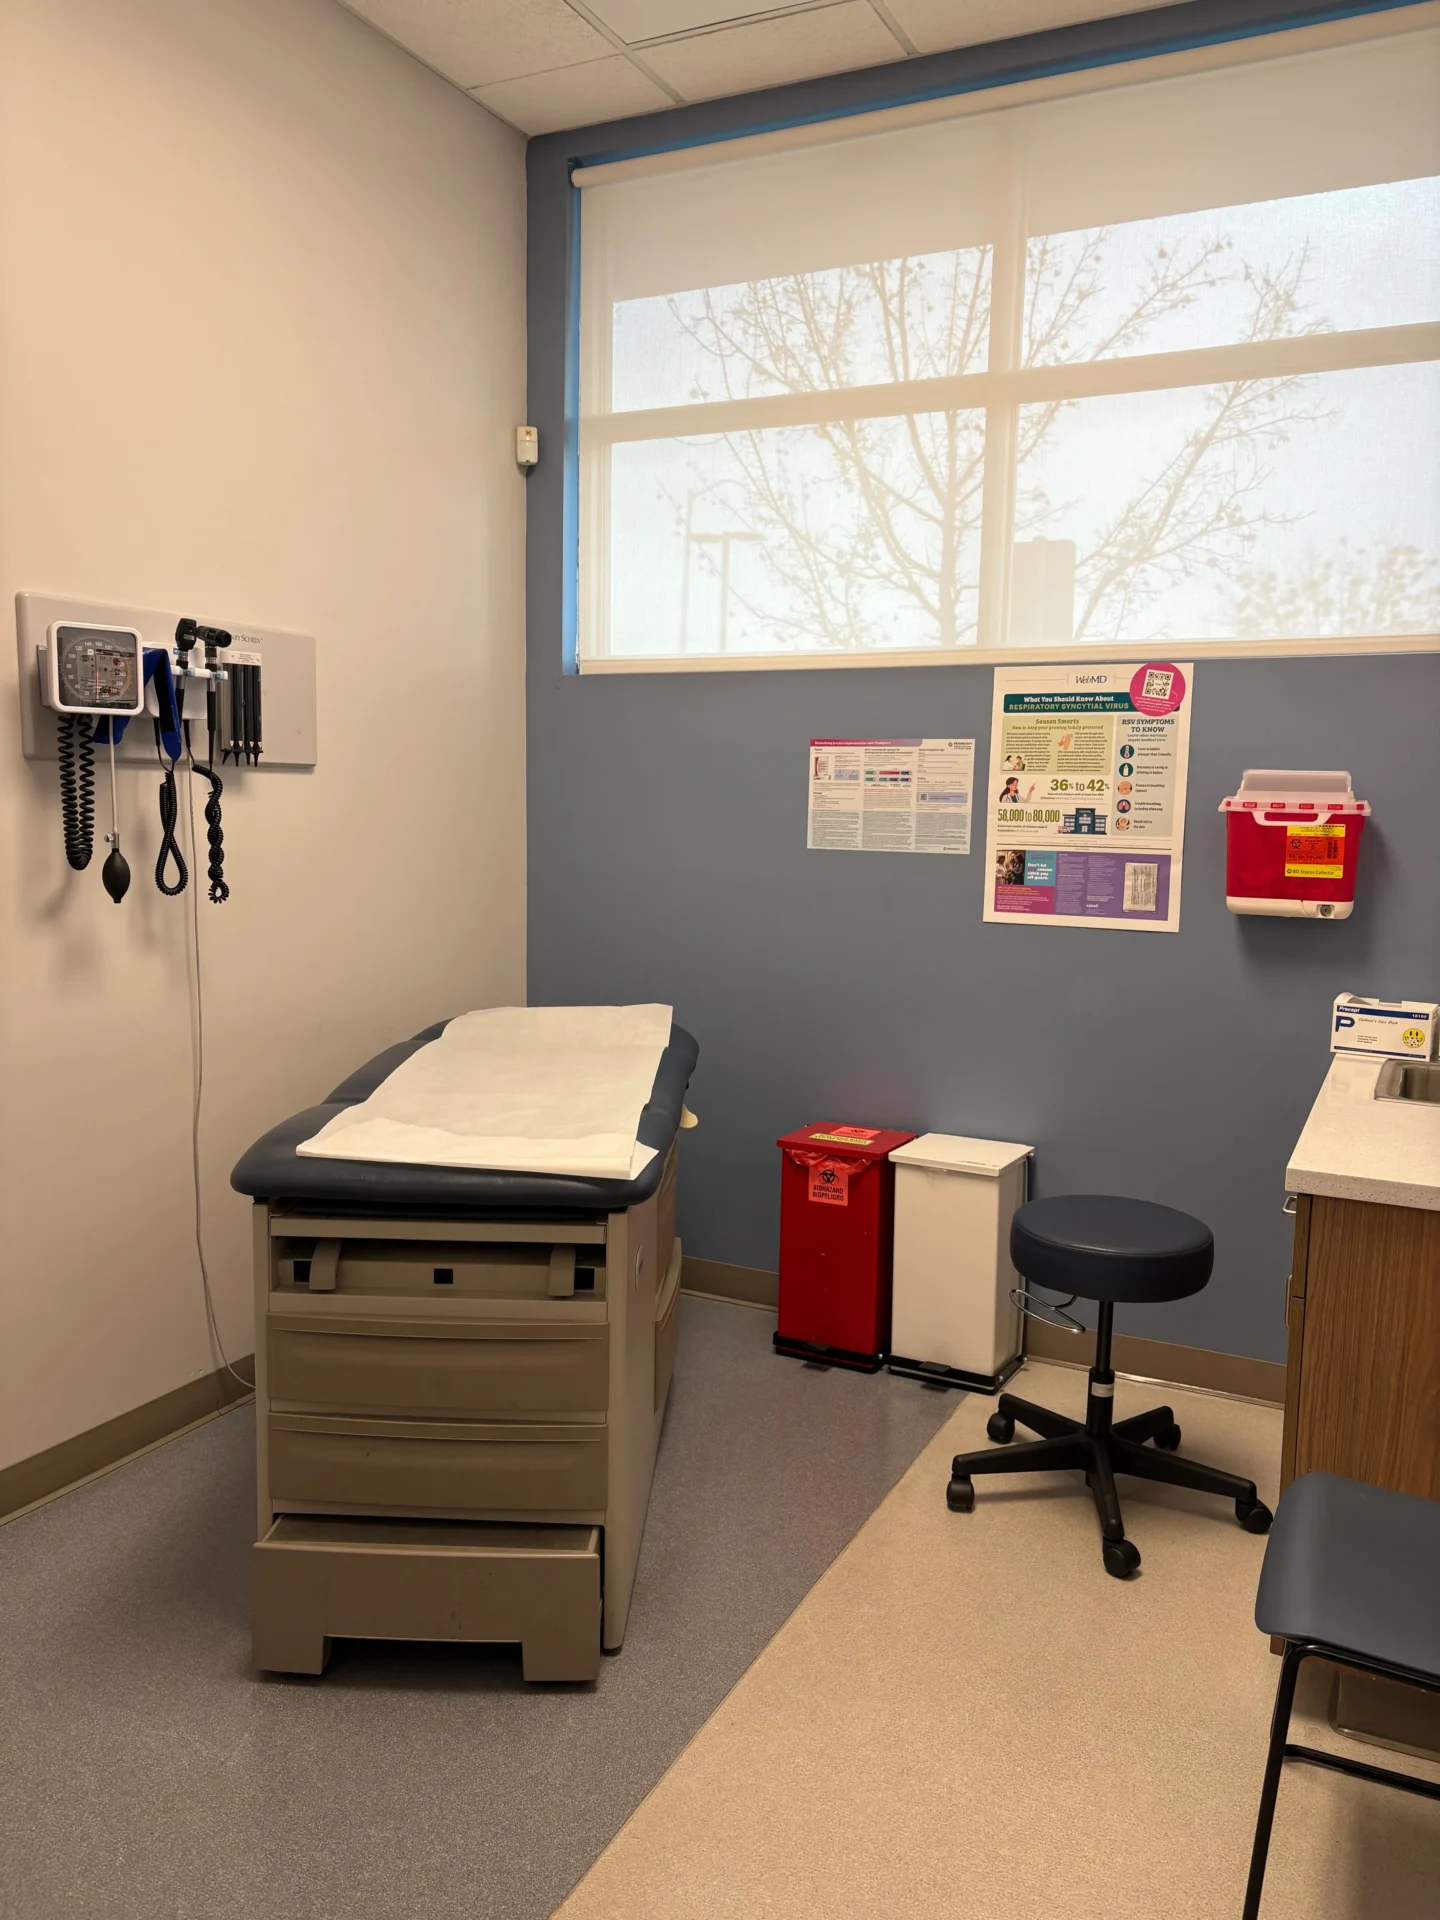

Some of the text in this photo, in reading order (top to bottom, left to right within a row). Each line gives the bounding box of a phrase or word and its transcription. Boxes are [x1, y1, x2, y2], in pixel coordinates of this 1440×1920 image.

[1075, 675, 1107, 684] WebMD
[1053, 695, 1075, 703] Should
[1009, 703, 1060, 711] RESPIRATORY
[1061, 702, 1104, 710] SYNCYTIAL
[1050, 778, 1110, 792] 36% to 42%
[997, 808, 1060, 824] 58,000 to 80,000
[1338, 1005, 1360, 1014] Precept
[813, 1184, 844, 1195] BIOHAZARD
[812, 1191, 844, 1202] BIOPELIGRO
